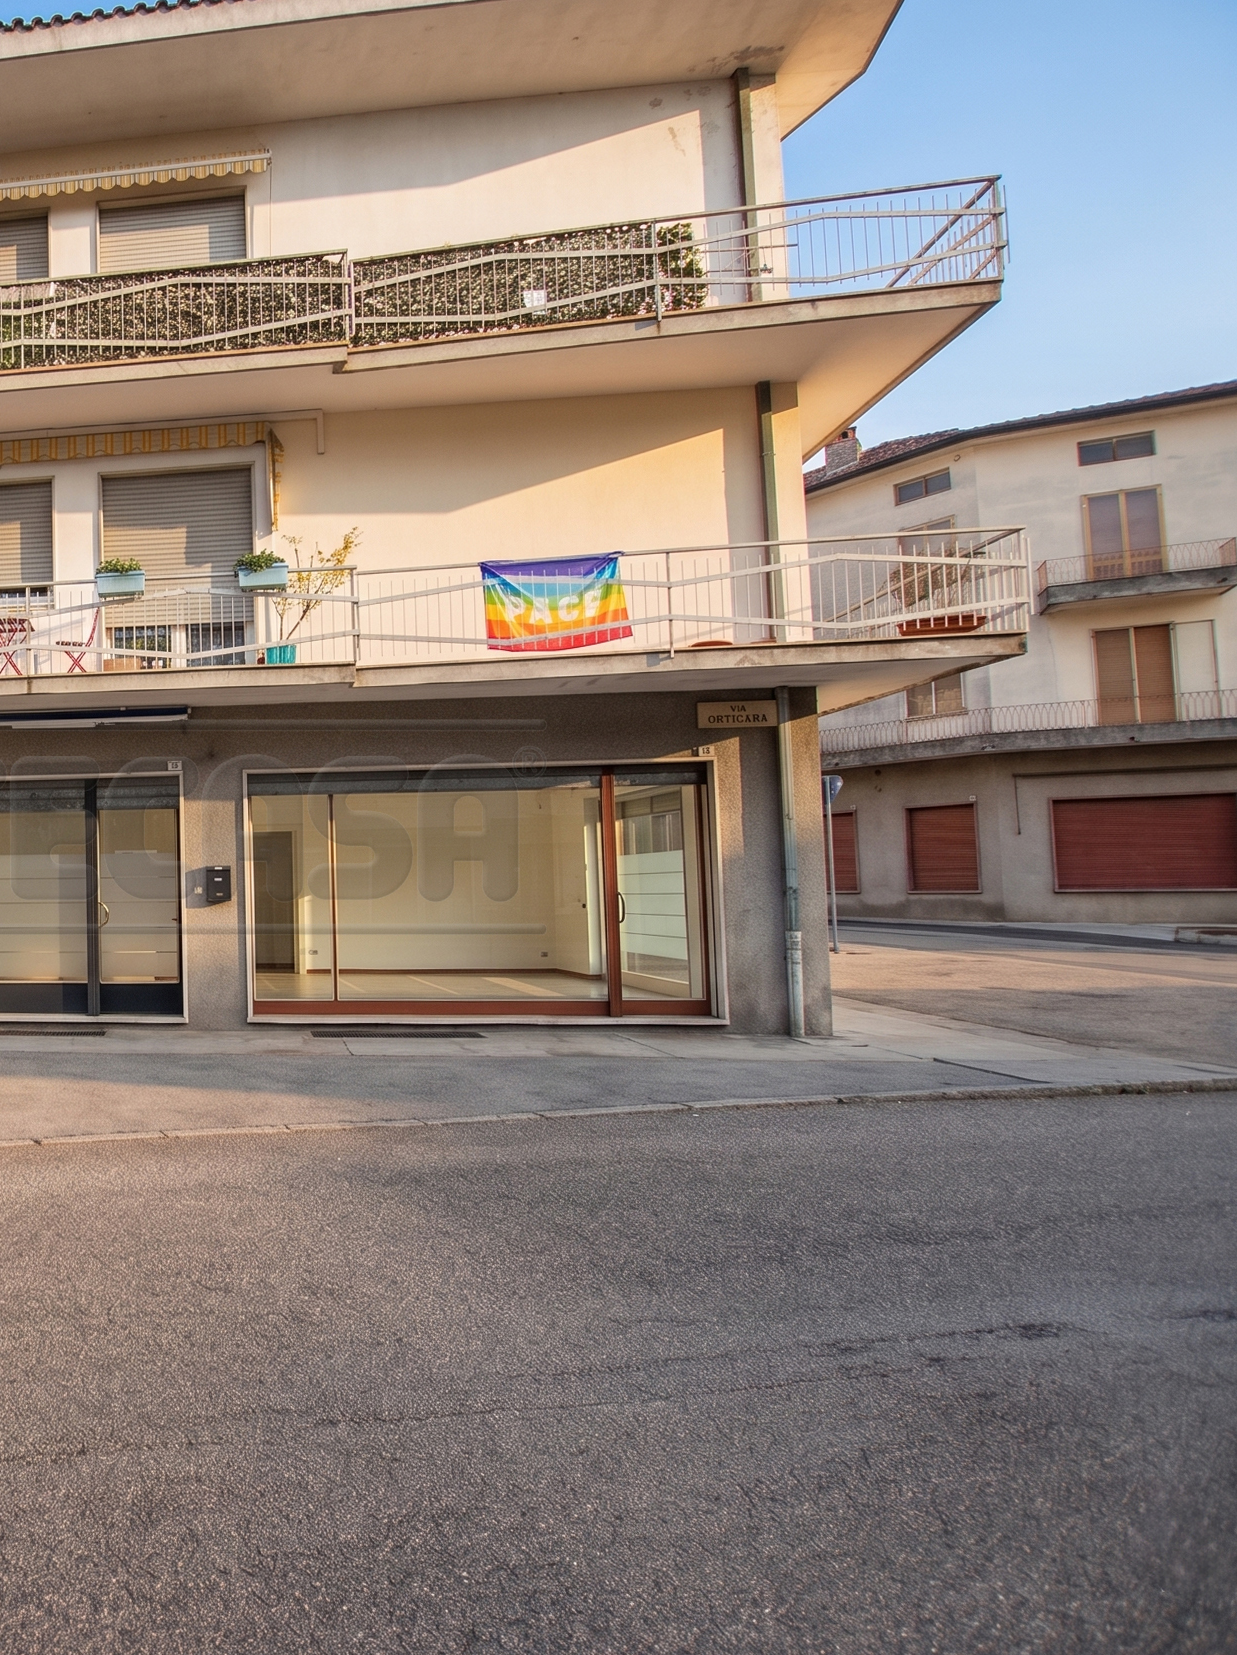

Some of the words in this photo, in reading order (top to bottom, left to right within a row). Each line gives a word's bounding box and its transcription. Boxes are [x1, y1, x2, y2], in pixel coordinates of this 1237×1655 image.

[504, 590, 602, 624] PACE
[730, 704, 746, 713] VIA
[707, 713, 768, 724] ORTICARA
